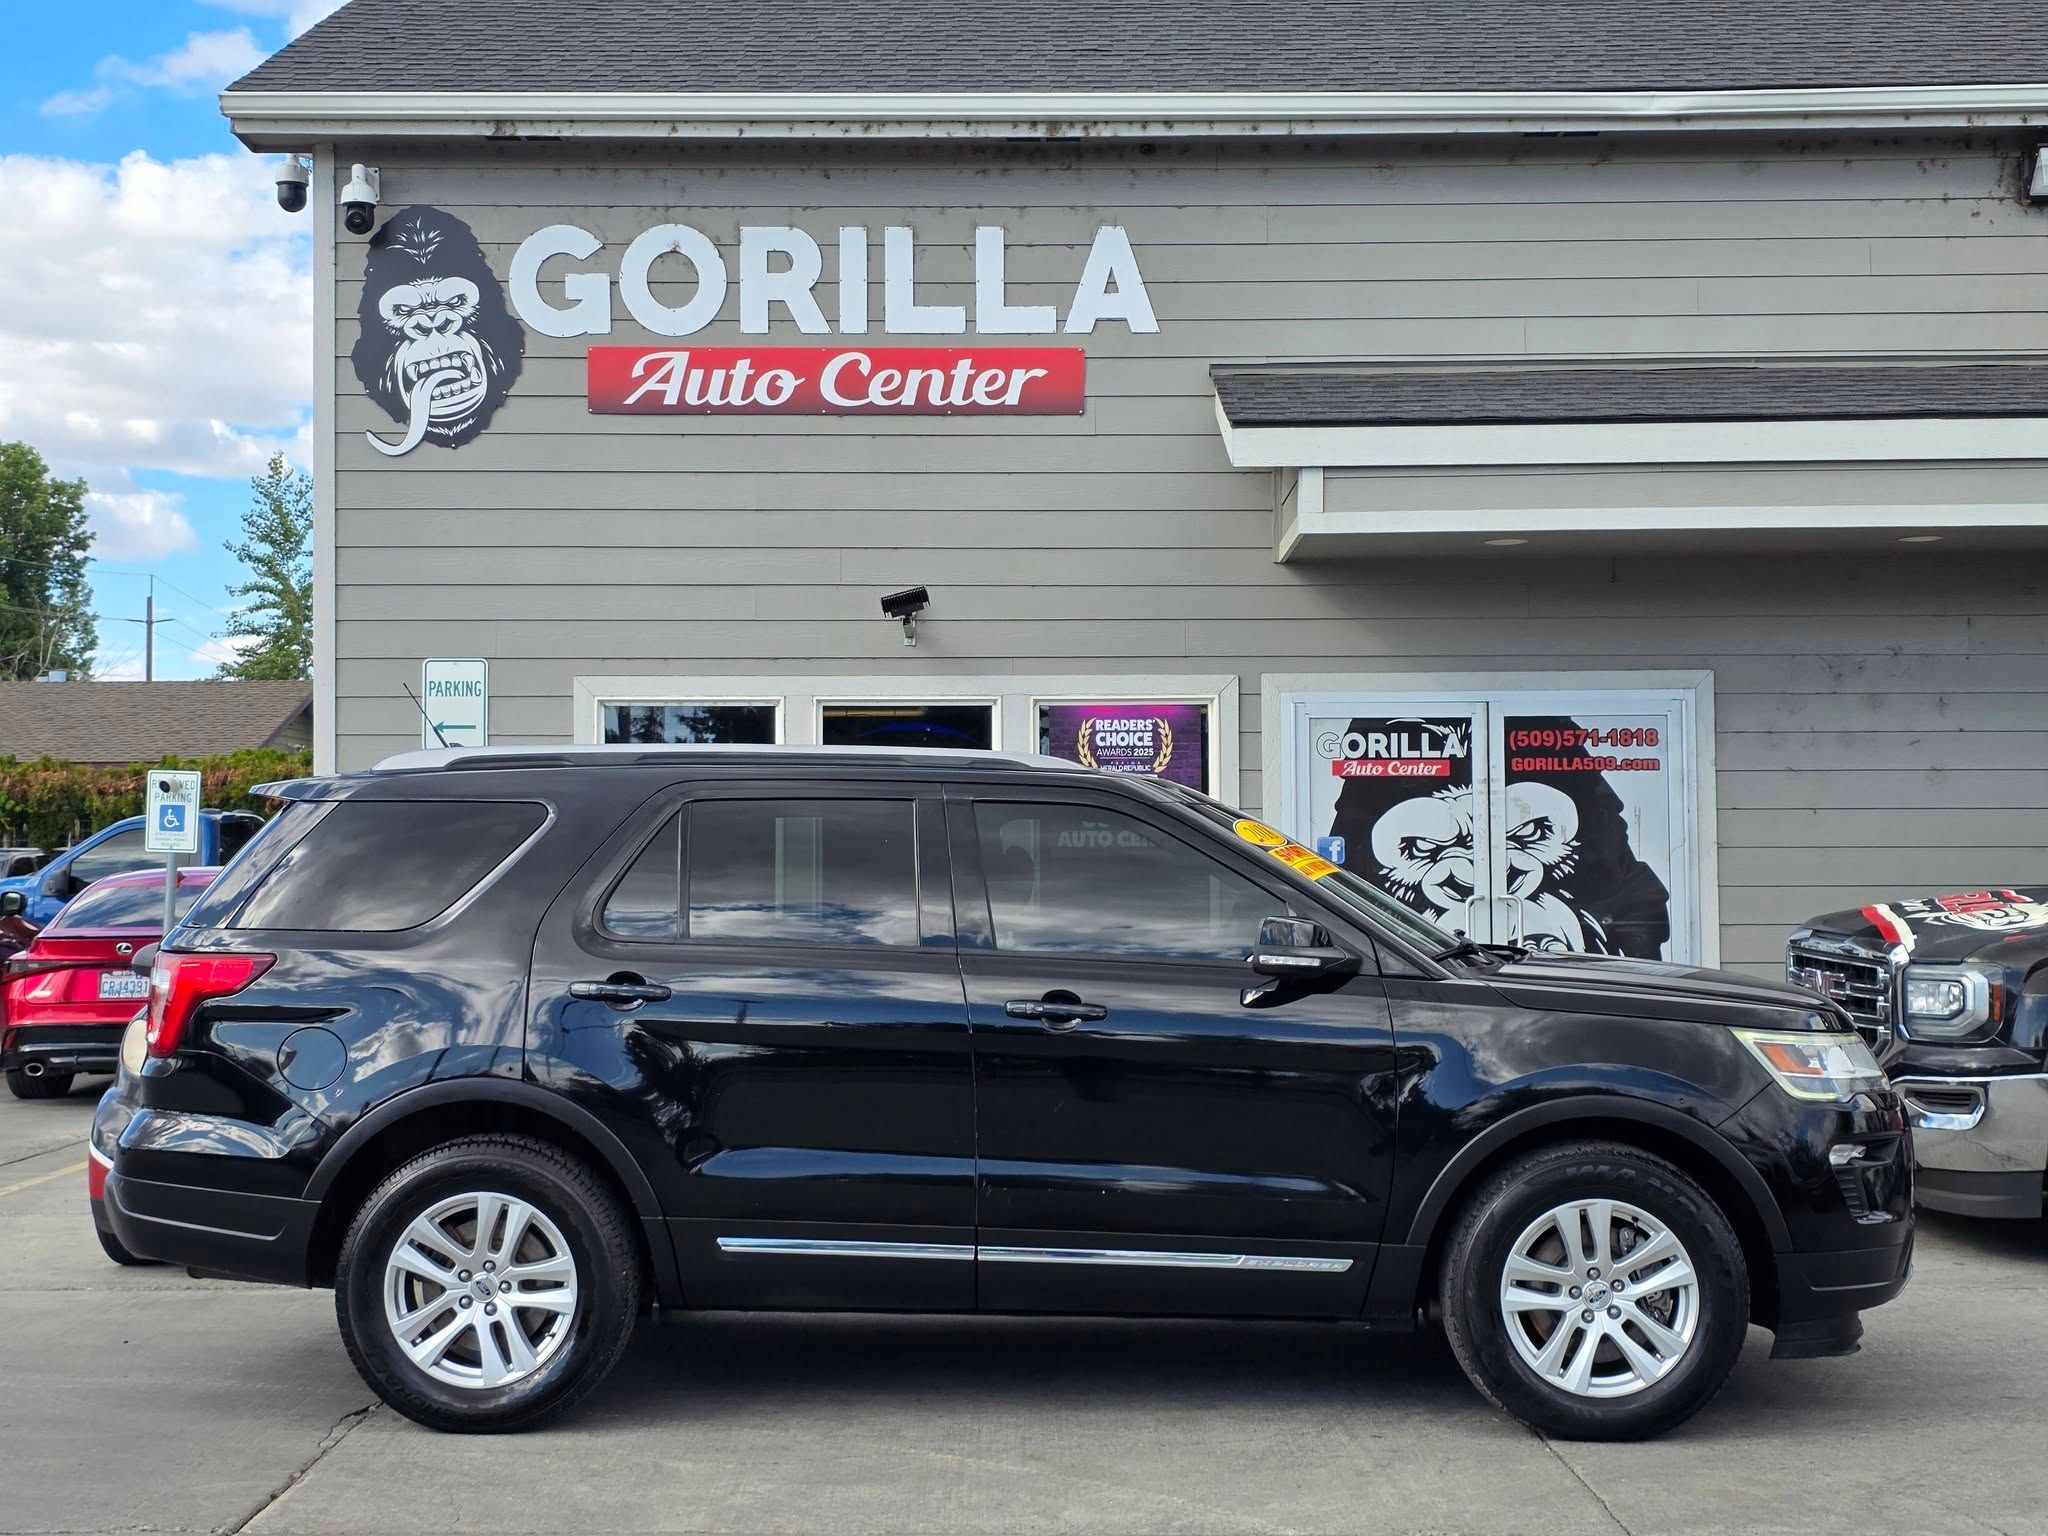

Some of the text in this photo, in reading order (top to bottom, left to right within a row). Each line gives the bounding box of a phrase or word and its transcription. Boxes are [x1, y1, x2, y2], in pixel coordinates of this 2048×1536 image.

[509, 224, 1161, 337] GORILLA
[623, 350, 1048, 406] Auto Center
[429, 680, 482, 697] PARKING
[1096, 732, 1153, 746] CHOICE
[1316, 731, 1465, 759] GORILLA
[1509, 728, 1660, 750] (509)571-1818
[1096, 748, 1154, 757] AWARDS 2025
[1342, 760, 1442, 776] Auto Center
[1511, 756, 1660, 771] GORILLA509.com
[154, 792, 192, 802] PARKING
